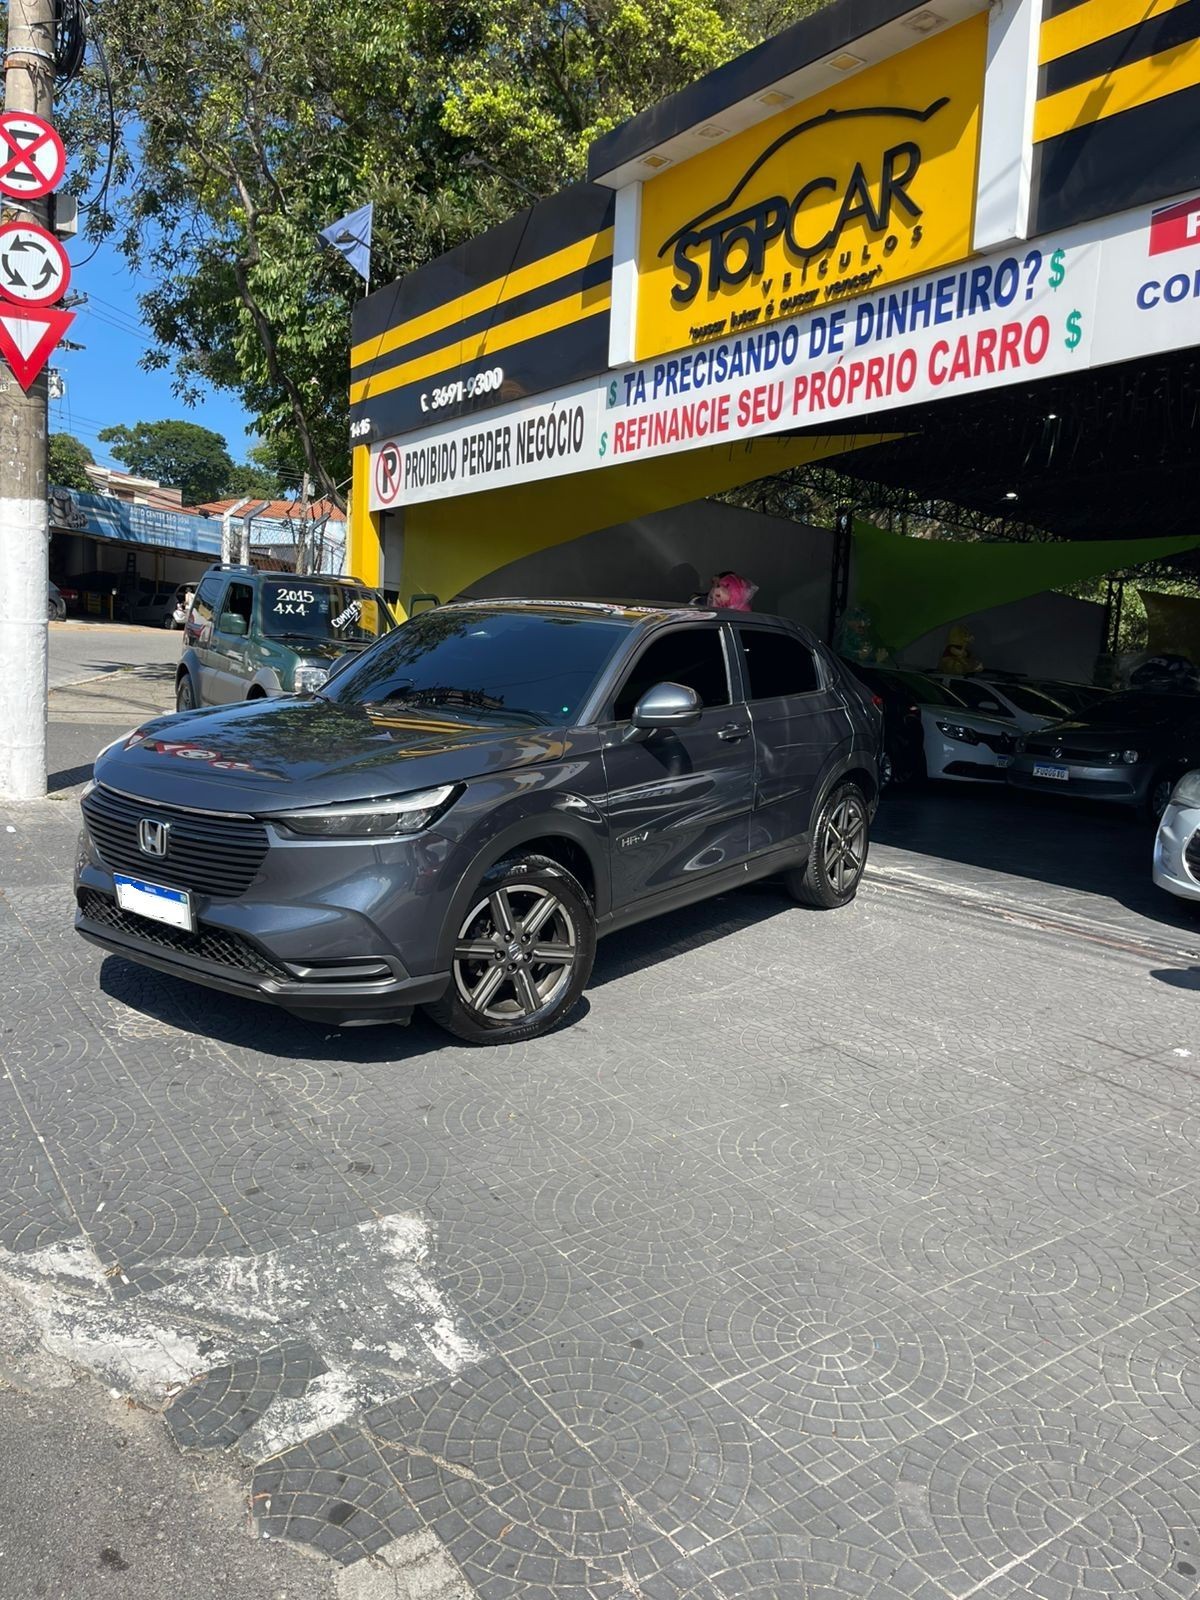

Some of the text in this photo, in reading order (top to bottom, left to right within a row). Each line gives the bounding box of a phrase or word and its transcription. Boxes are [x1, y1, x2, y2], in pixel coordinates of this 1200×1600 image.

[671, 141, 923, 302] STOPCAR
[623, 368, 647, 407] TA
[653, 323, 799, 400] PRECISANDO
[809, 309, 846, 360] DE
[855, 249, 1042, 347] DINHEIRO?
[431, 366, 504, 410] 3691-9300
[613, 393, 731, 454] REFINANCIE
[737, 380, 784, 428] SEU
[792, 347, 917, 415] PRÓPRIO
[928, 314, 1050, 386] CARRO
[404, 443, 457, 489] PROIBIDO
[461, 426, 511, 478] PERDER
[516, 402, 584, 466] NEGÓCIO
[146, 509, 165, 520] CENTER
[276, 588, 315, 603] 2015
[621, 831, 649, 848] HR-V
